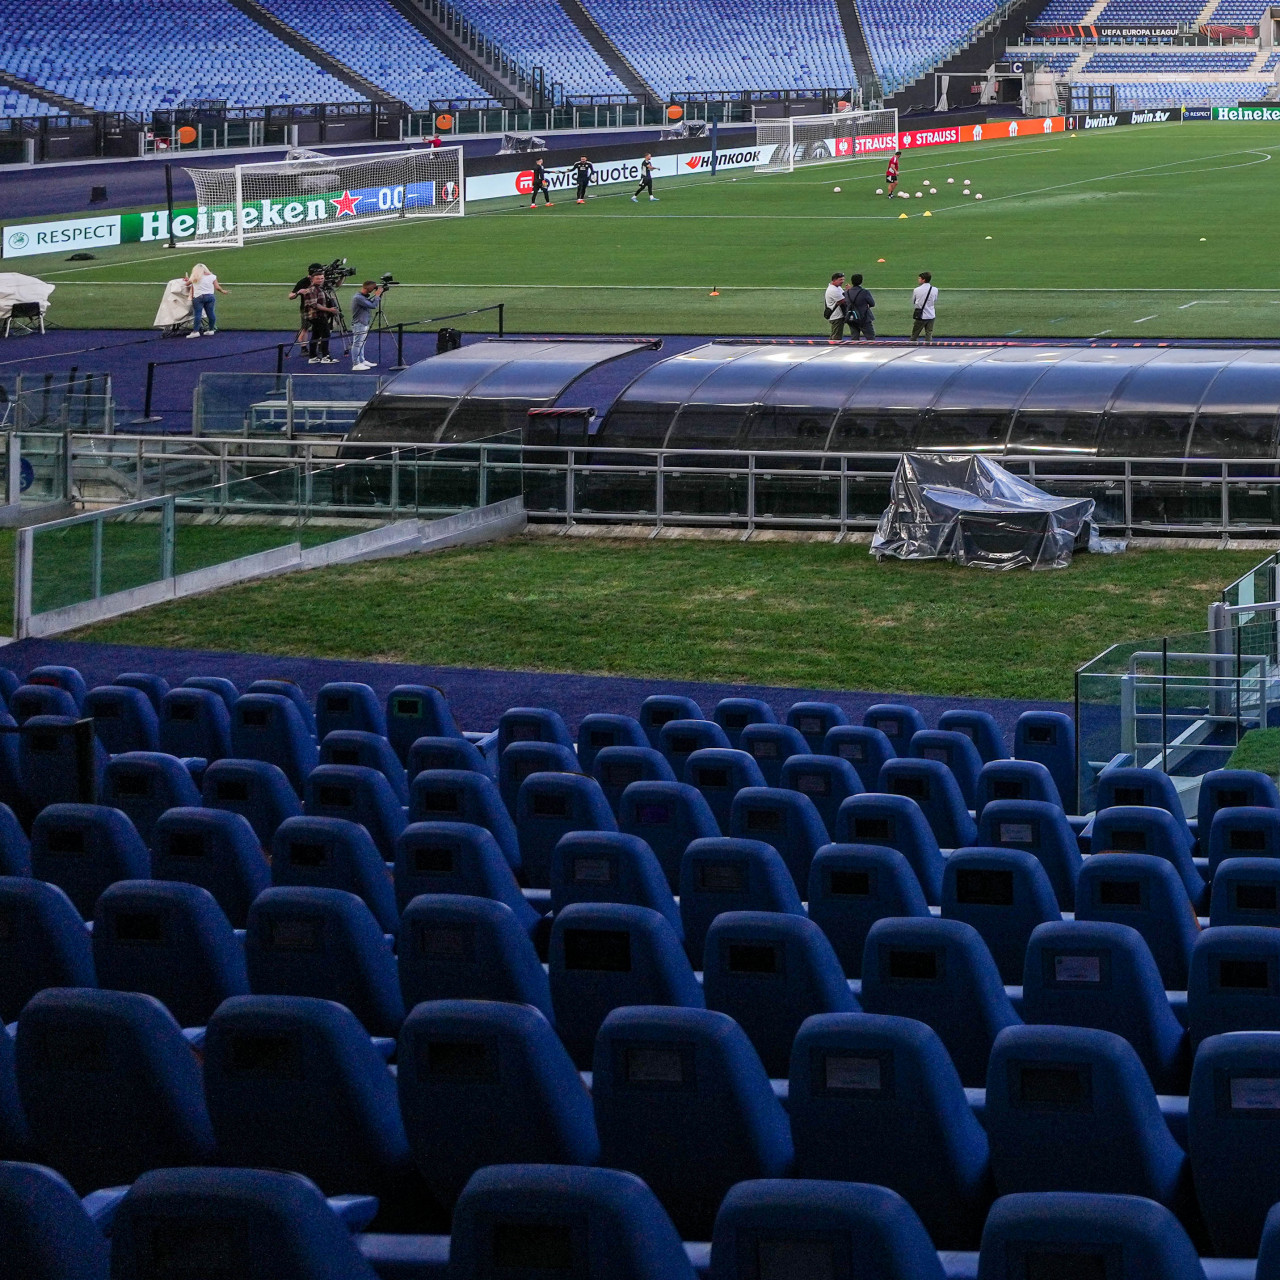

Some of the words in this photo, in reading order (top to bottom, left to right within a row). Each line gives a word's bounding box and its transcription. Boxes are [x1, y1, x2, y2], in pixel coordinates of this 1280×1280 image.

[1013, 63, 1023, 73] C
[1085, 114, 1118, 128] bwin.tv
[1131, 110, 1171, 124] bwin.tv
[855, 134, 897, 152] STRAUSS
[916, 129, 957, 145] STRAUSS
[140, 199, 328, 242] Heineken
[37, 224, 117, 245] RESPECT
